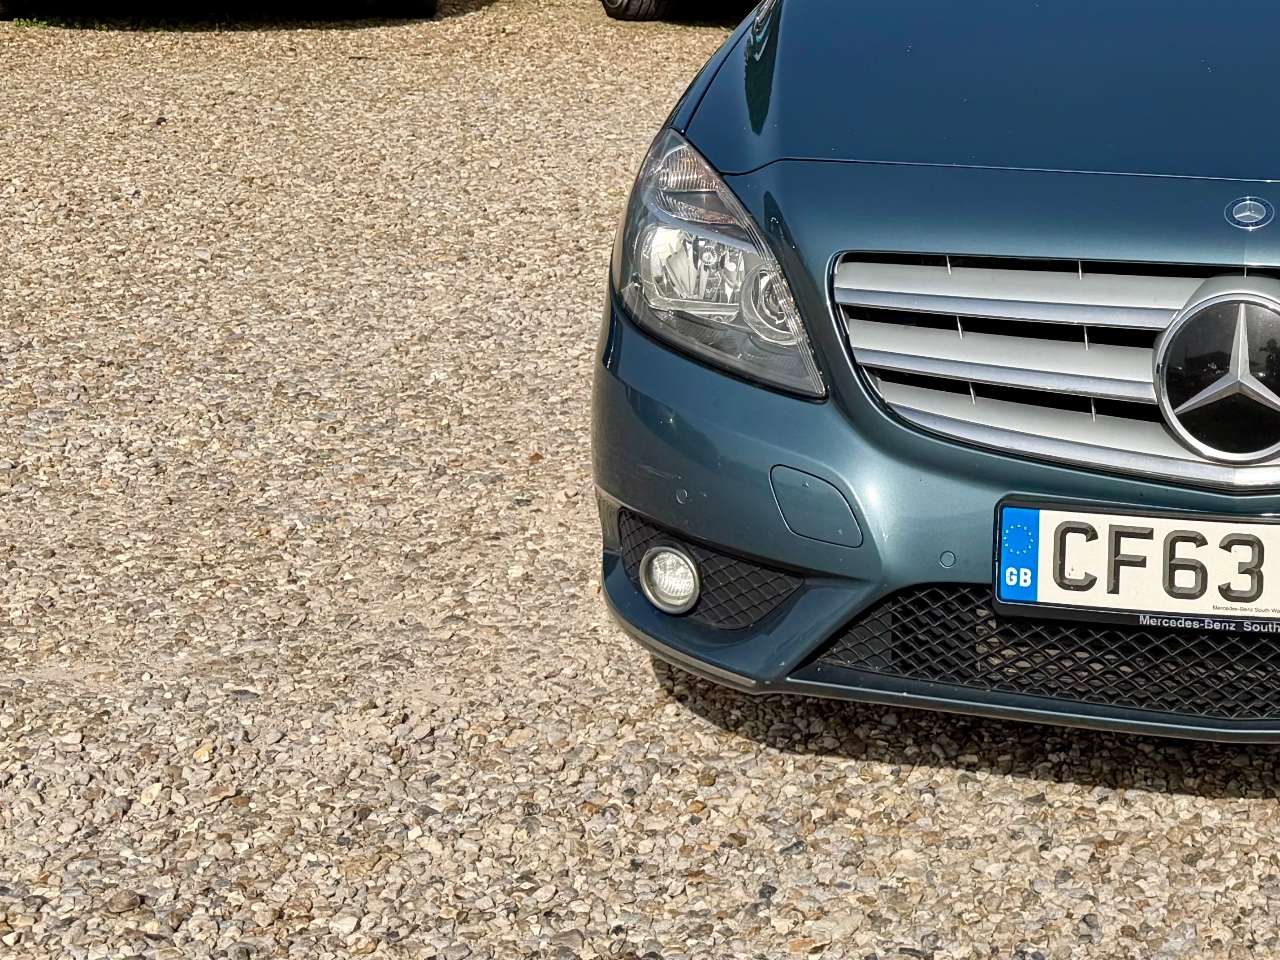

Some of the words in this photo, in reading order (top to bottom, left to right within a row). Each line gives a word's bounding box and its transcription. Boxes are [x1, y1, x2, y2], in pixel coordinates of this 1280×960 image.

[1053, 520, 1265, 603] CF63
[1005, 567, 1032, 587] GB
[1138, 615, 1236, 631] Mercedes-Benz
[1243, 621, 1280, 633] South
